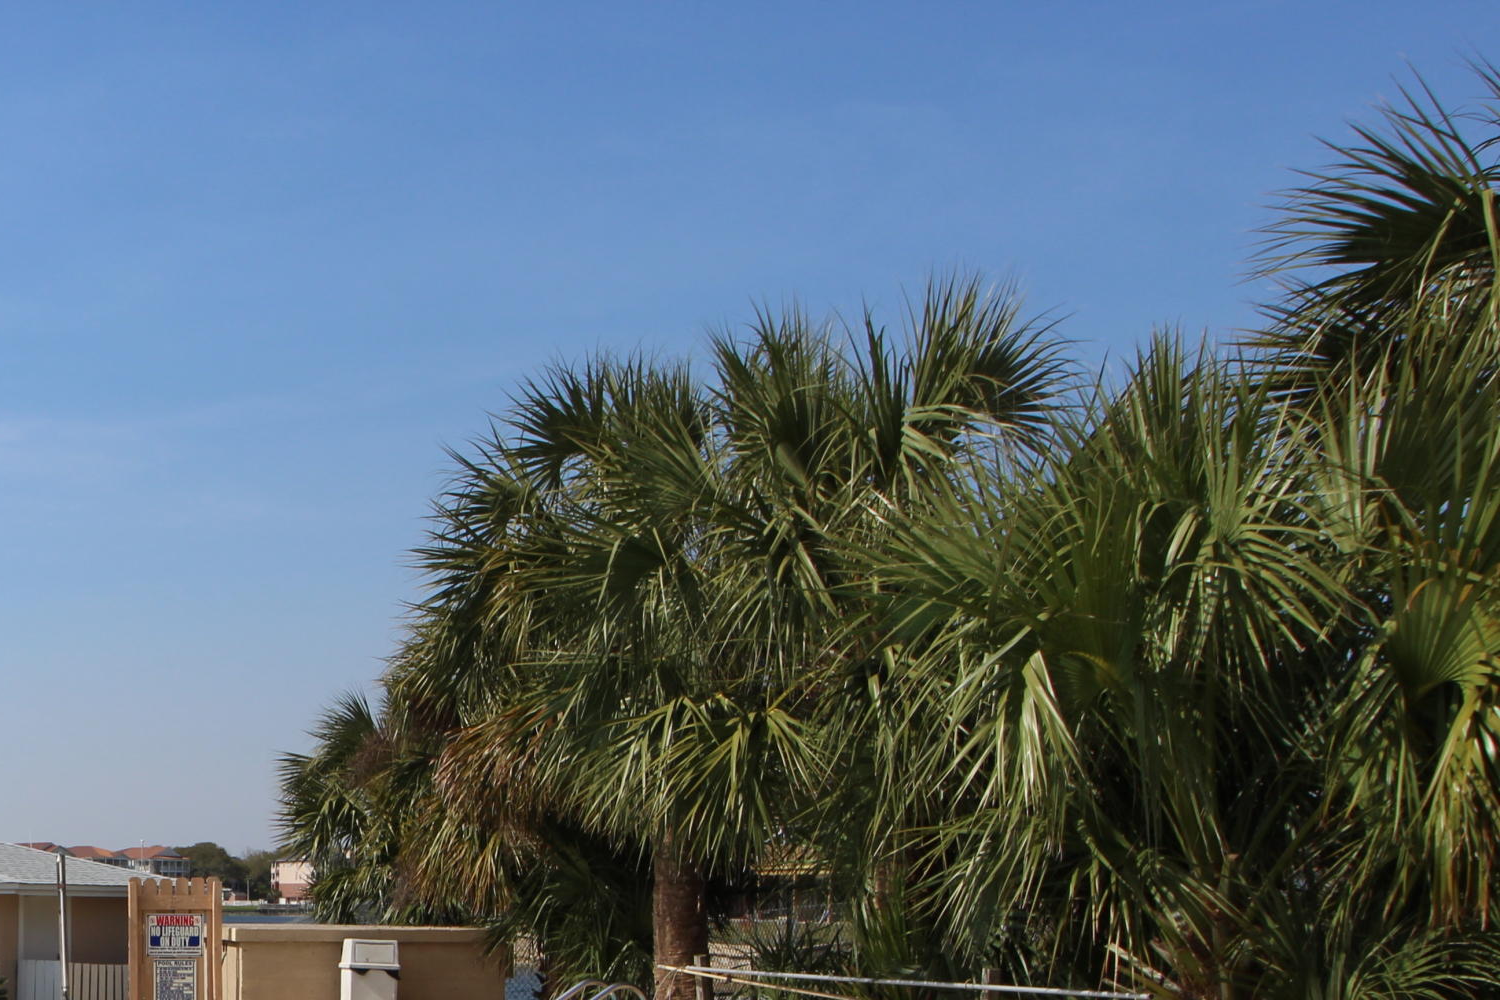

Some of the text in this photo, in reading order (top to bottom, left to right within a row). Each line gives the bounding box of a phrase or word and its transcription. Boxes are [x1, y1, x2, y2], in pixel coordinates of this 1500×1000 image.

[156, 915, 194, 926] WARNING
[151, 926, 199, 936] NO LIFEGUARD
[160, 936, 190, 947] ON DUTY
